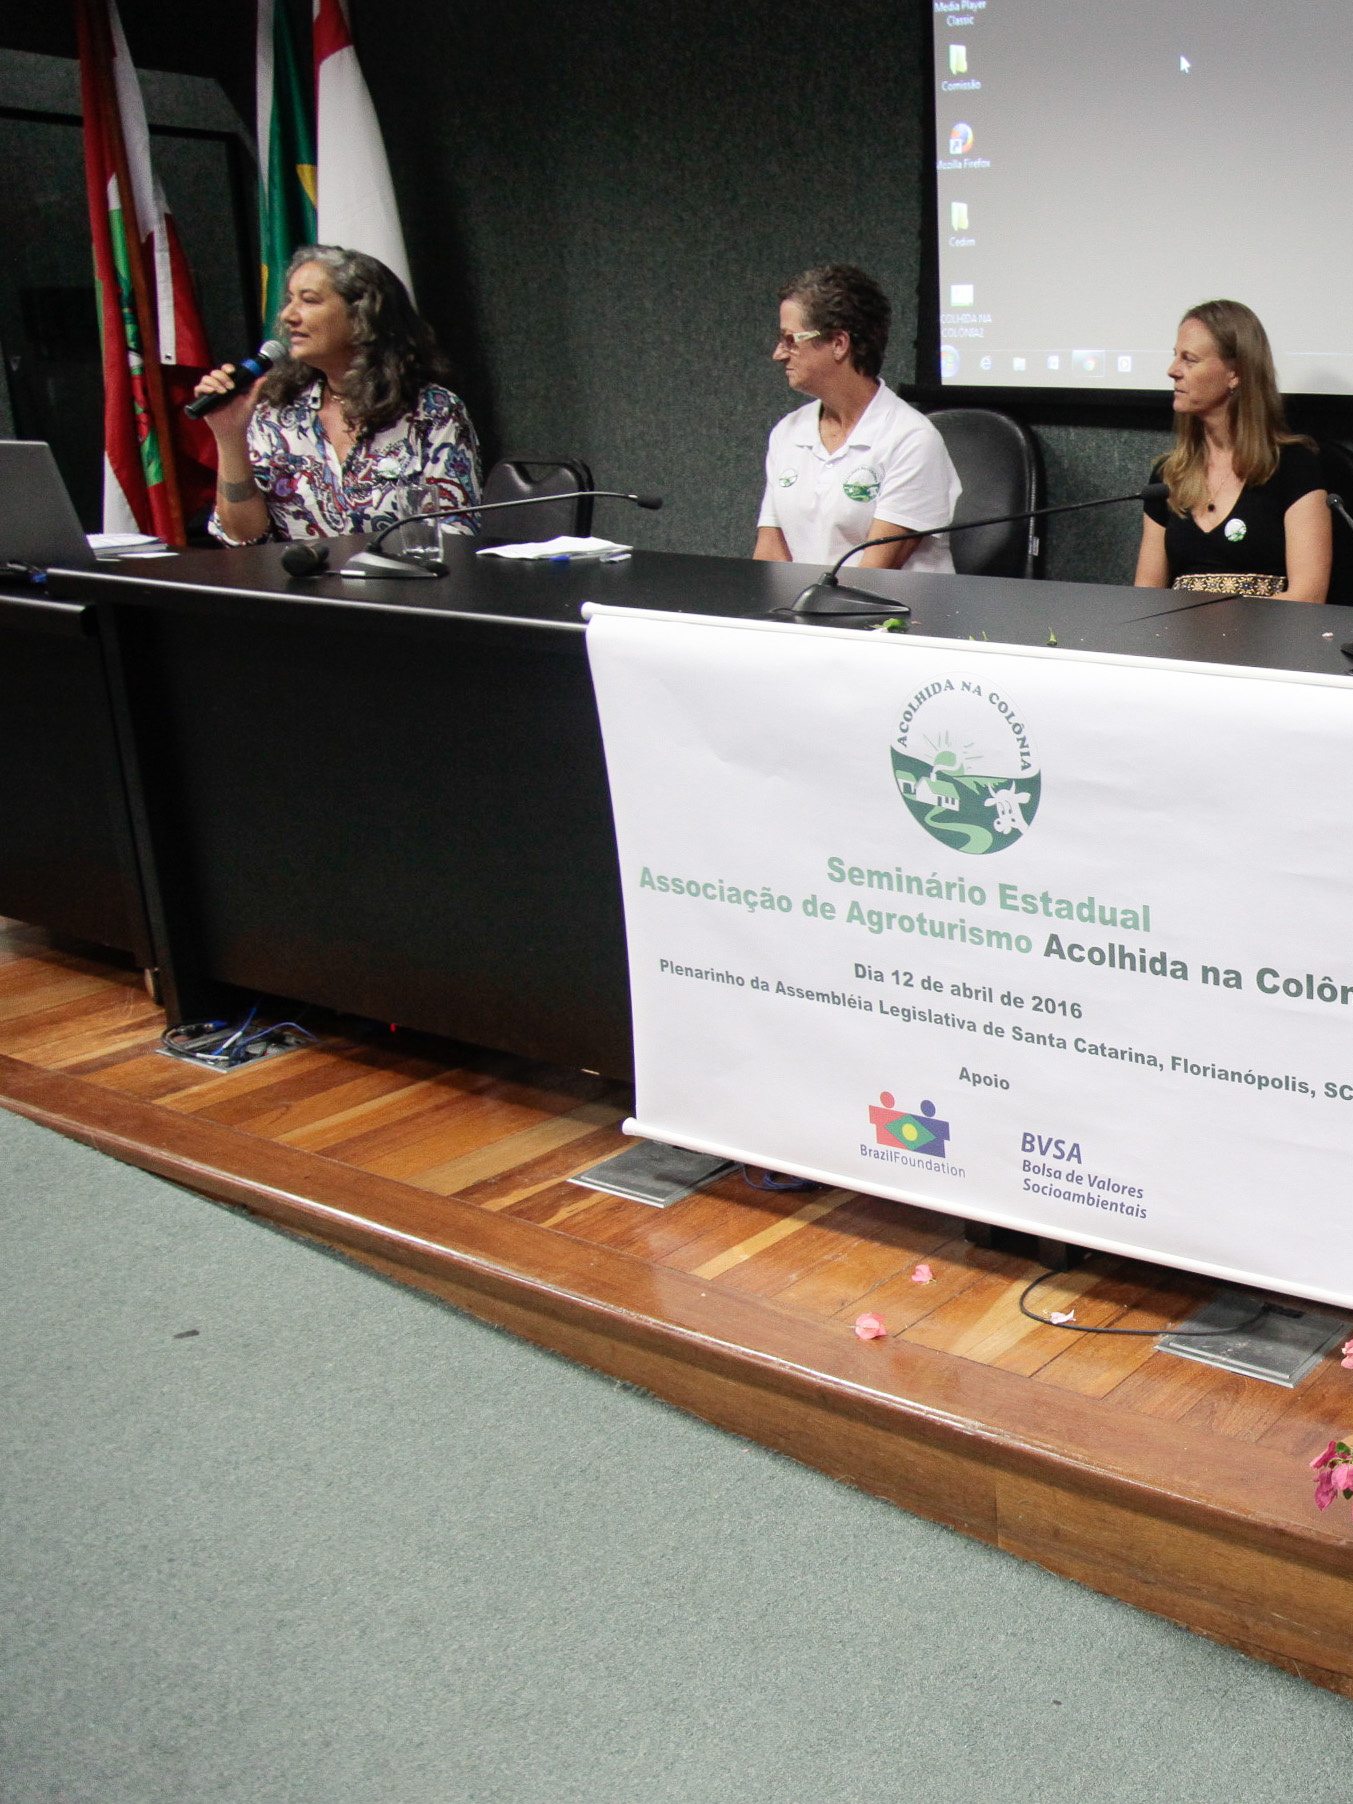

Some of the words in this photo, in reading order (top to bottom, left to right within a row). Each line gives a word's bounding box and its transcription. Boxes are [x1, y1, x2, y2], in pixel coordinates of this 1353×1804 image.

[946, 15, 974, 27] Classic
[963, 157, 991, 168] Firefox
[897, 679, 955, 748] ACOLHIDA
[960, 681, 983, 697] NA
[988, 692, 1032, 772] COLÔNIA
[827, 856, 986, 906] Seminário
[998, 883, 1151, 932] Estadual
[640, 866, 793, 913] Associação
[802, 894, 836, 920] de
[845, 900, 1033, 954] Agroturismo
[1043, 933, 1189, 981] Acolhida
[1201, 965, 1243, 990] na
[854, 963, 884, 983] Dia
[891, 969, 914, 988] 12
[921, 975, 944, 993] de
[950, 982, 993, 1004] abril
[1000, 990, 1024, 1009] de
[1031, 995, 1083, 1019] 2016
[659, 958, 745, 987] Plenarinho
[750, 975, 770, 992] da
[775, 980, 873, 1012] Assembléia
[879, 999, 977, 1033] Legislativa
[982, 1020, 1005, 1038] de
[1011, 1025, 1067, 1050] Santa
[1074, 1037, 1164, 1072] Catarina,
[1171, 1055, 1316, 1098] Florianópolis,
[1323, 1082, 1353, 1101] SC
[958, 1066, 1010, 1091] Apoio
[859, 1144, 966, 1178] BrazilFoundation
[1020, 1132, 1082, 1165] BVSA
[1022, 1159, 1062, 1181] Bolsa
[1065, 1169, 1084, 1186] de
[1087, 1173, 1144, 1199] Valores
[1022, 1177, 1147, 1219] Socioambientais
